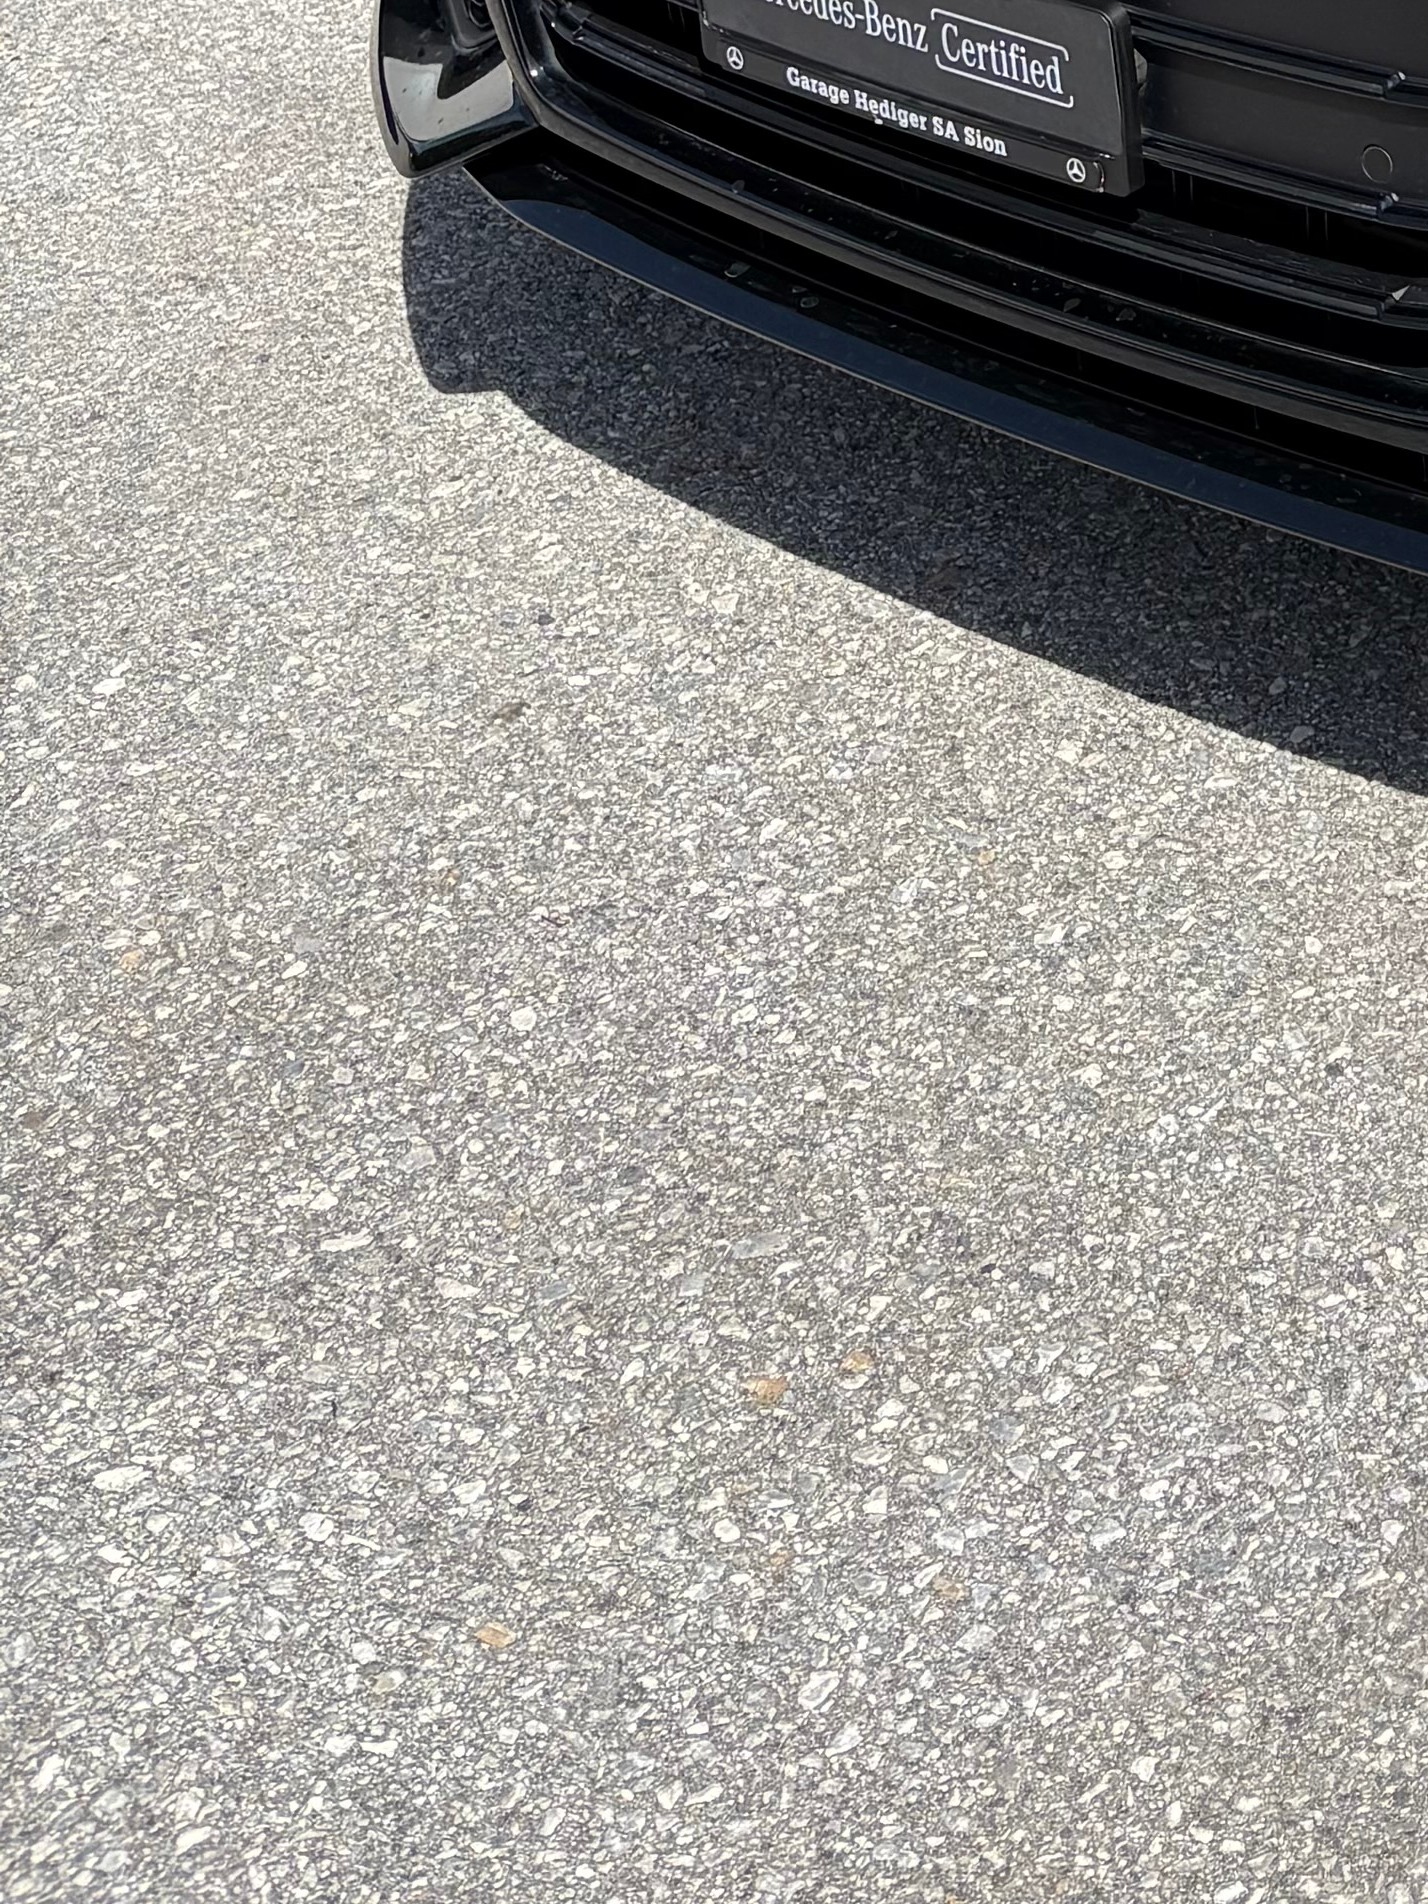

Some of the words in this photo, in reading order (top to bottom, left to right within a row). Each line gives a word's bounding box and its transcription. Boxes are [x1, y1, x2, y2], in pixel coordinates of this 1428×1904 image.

[941, 22, 1064, 94] Certified
[786, 66, 850, 104] Garage
[853, 89, 927, 131] Hediger
[931, 116, 960, 142] SA
[964, 126, 1008, 157] Sion
